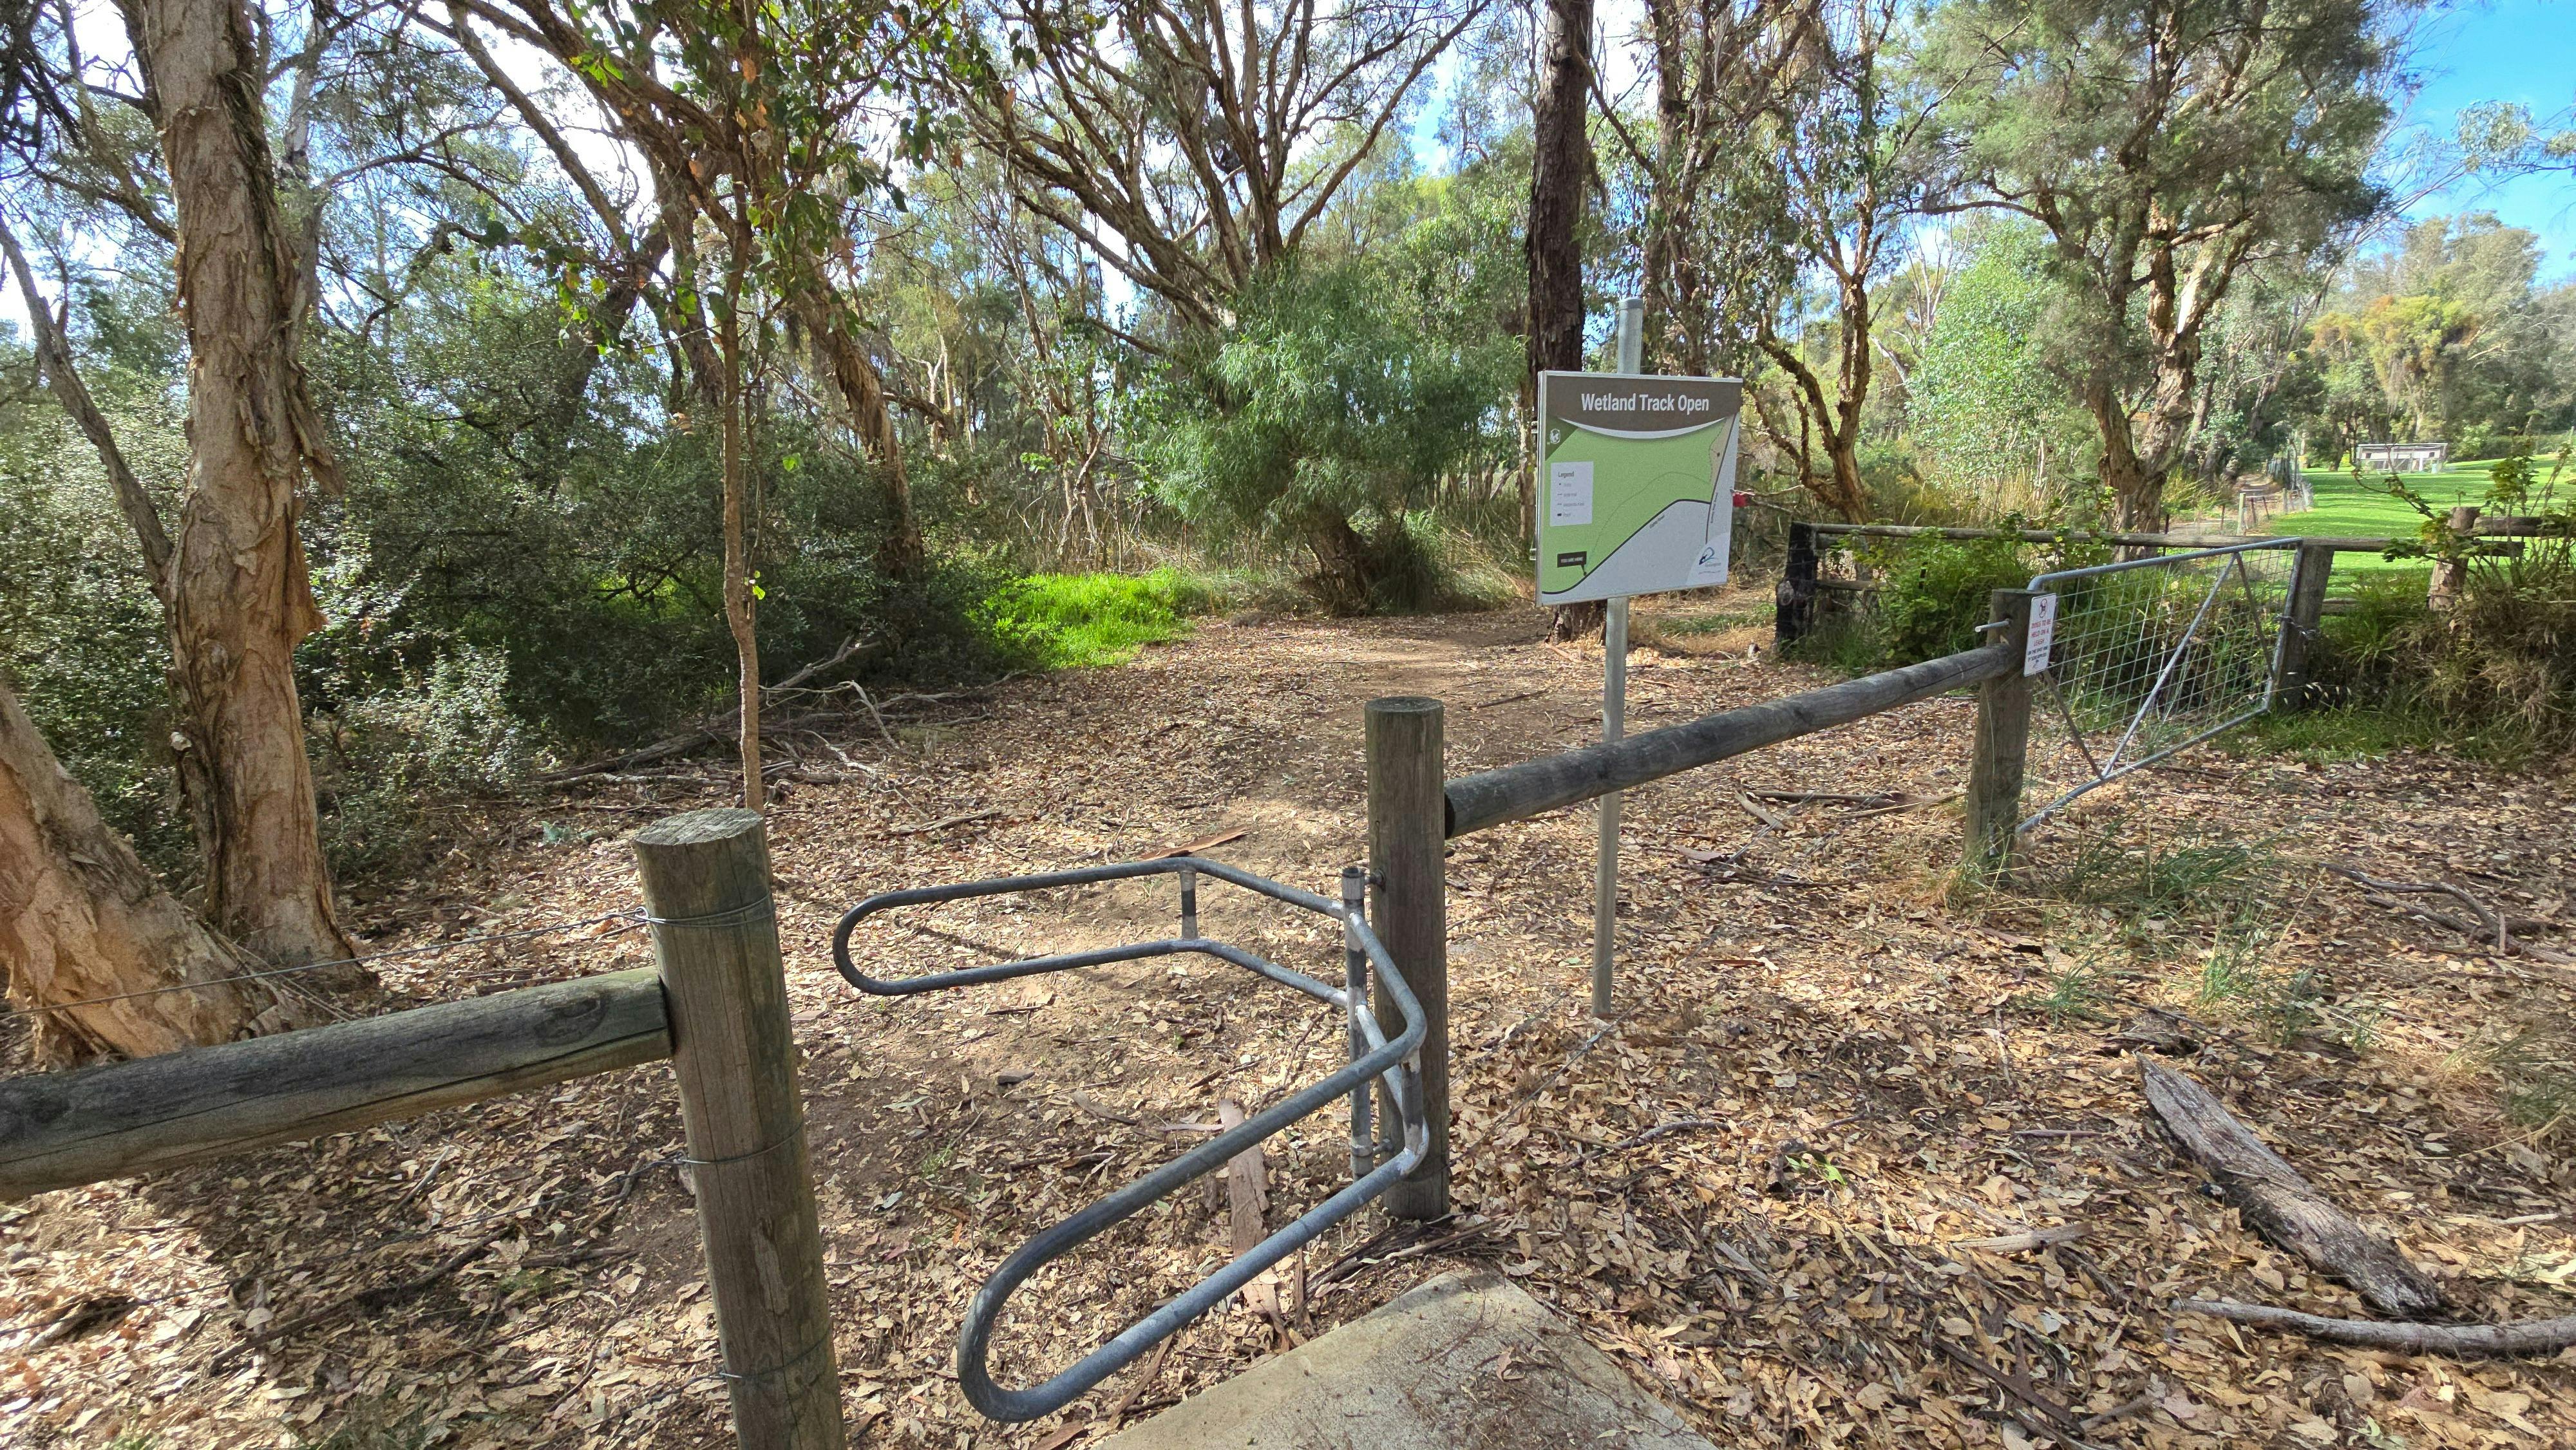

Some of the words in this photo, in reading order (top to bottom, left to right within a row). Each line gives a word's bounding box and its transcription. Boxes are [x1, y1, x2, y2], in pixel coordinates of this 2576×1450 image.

[1581, 393, 1636, 411] Wetland
[1639, 393, 1675, 411] Track
[1678, 395, 1709, 415] Open
